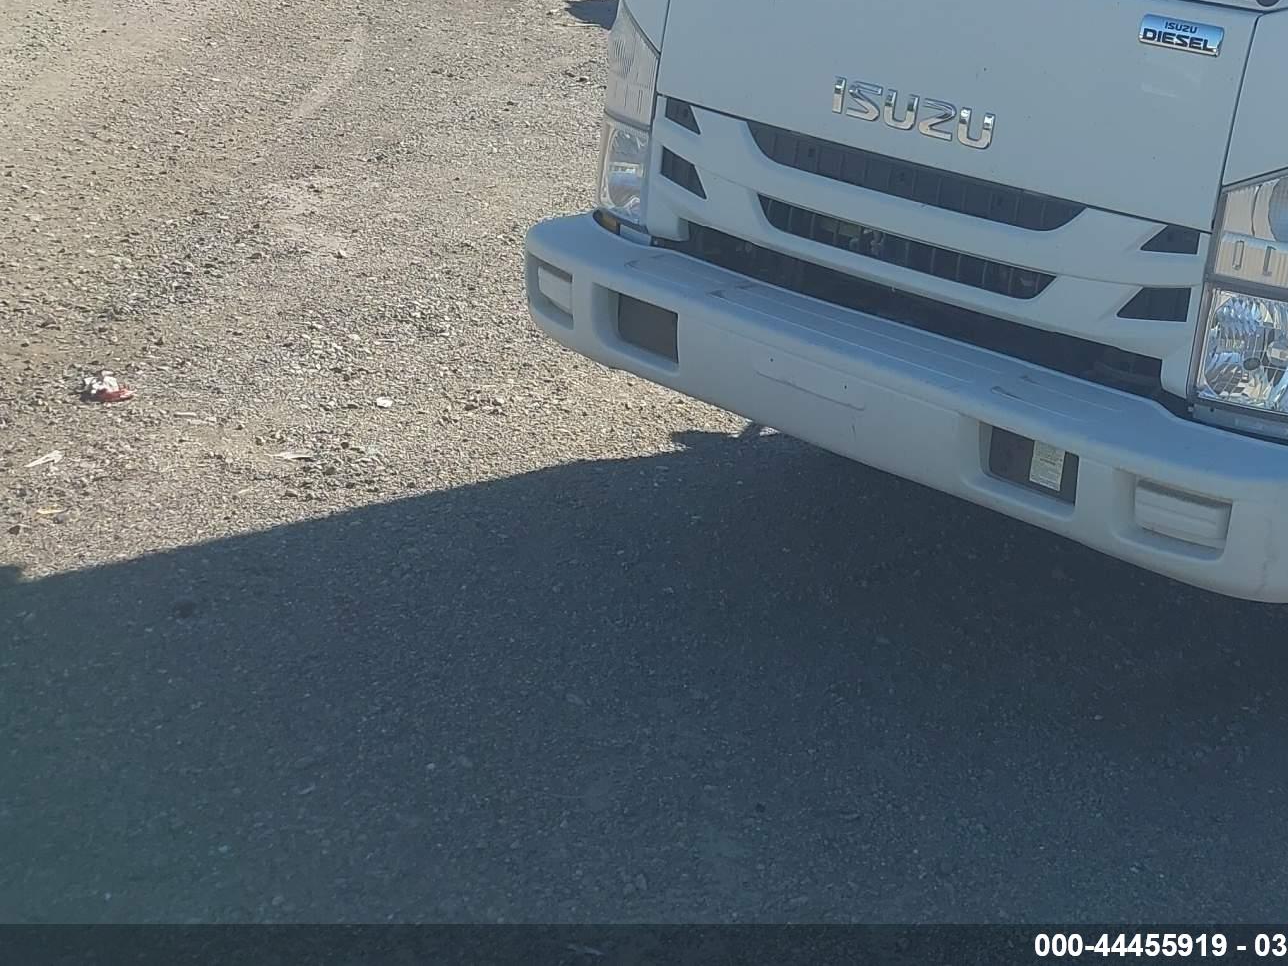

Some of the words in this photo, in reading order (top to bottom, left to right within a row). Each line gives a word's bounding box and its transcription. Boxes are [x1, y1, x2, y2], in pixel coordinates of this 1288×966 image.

[1140, 27, 1217, 52] DIESEL
[1164, 20, 1198, 35] ISUZU
[830, 74, 997, 150] ISUZU
